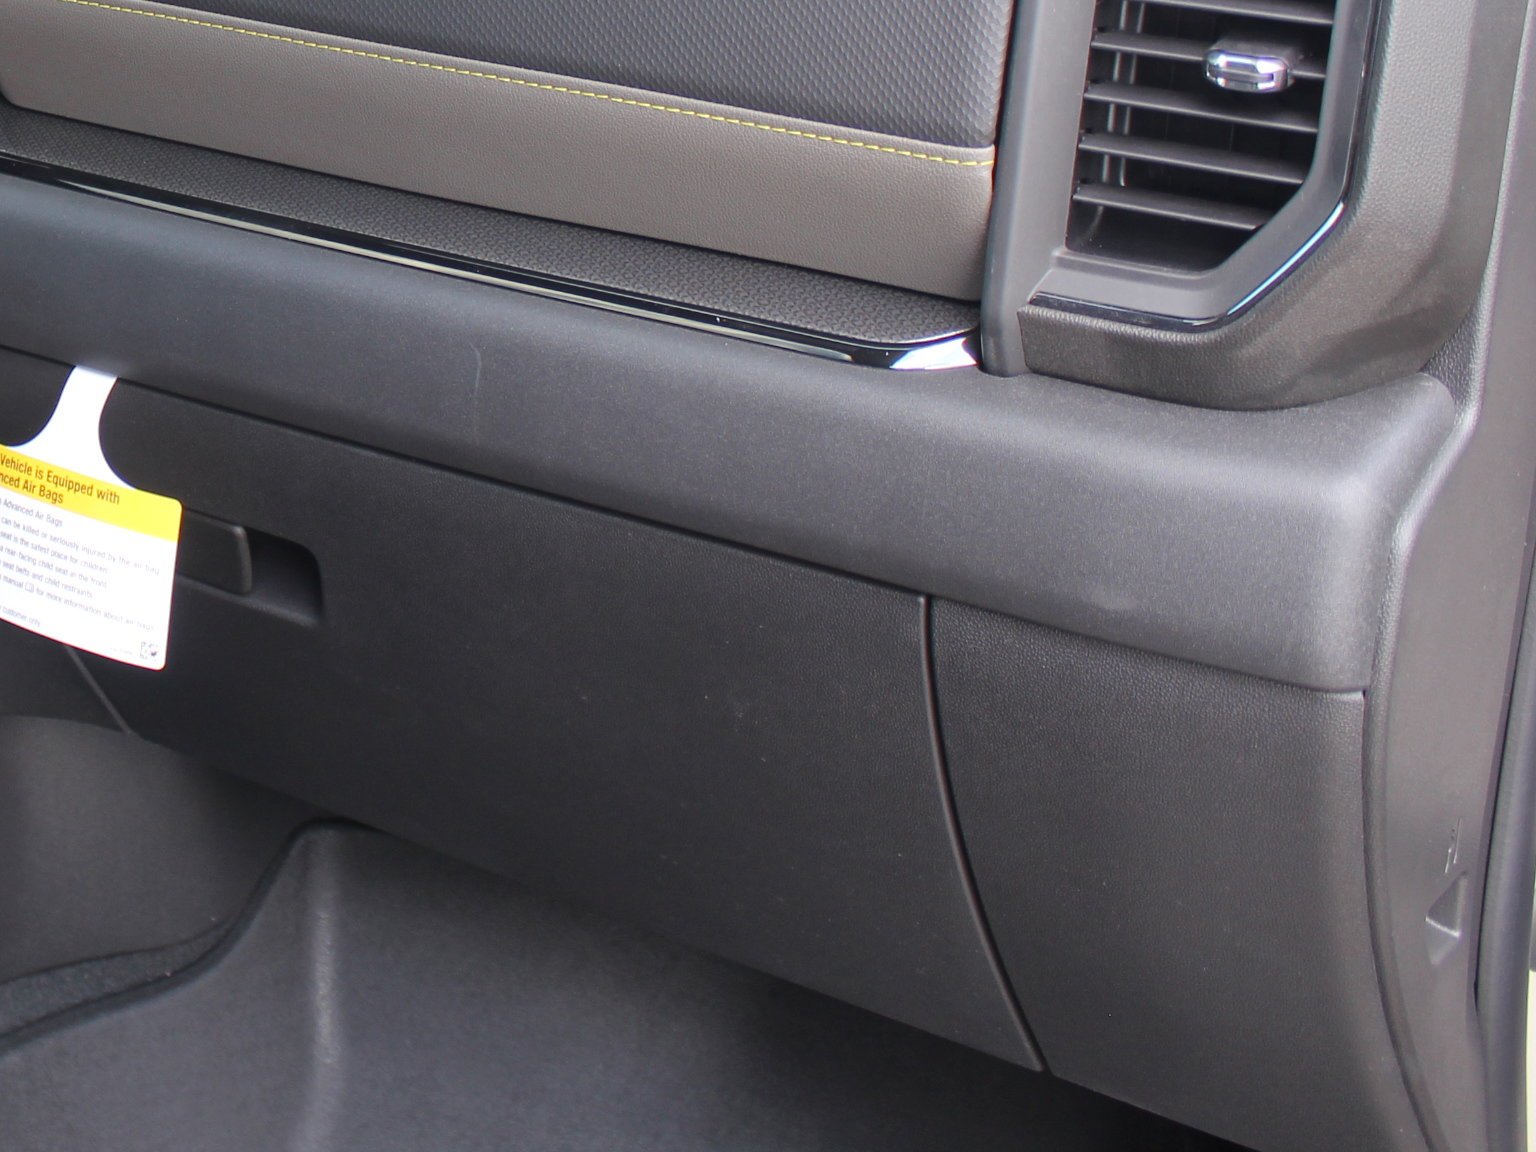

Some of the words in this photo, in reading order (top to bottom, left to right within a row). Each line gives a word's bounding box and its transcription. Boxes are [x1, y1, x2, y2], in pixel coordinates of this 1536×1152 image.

[0, 453, 32, 476] Vehicle
[35, 466, 43, 480] is
[47, 470, 94, 497] Equipped
[96, 488, 120, 505] with
[22, 479, 36, 495] Air
[38, 485, 64, 505] Bags
[3, 498, 34, 517] Advanced
[35, 510, 44, 520] Air
[46, 513, 62, 527] Bags
[0, 531, 13, 541] seat
[13, 535, 19, 543] is
[19, 537, 29, 548] the
[31, 542, 49, 554] safest
[51, 550, 68, 561] place
[70, 555, 78, 564] for
[1, 517, 12, 526] can
[13, 519, 21, 529] be
[22, 524, 40, 536] killed
[49, 534, 79, 551] seriously
[82, 544, 106, 558] injured
[107, 552, 116, 563] by
[119, 555, 131, 565] the
[2, 560, 15, 571] seat
[16, 565, 30, 577] belts
[31, 572, 44, 582] and
[45, 577, 61, 588] child
[38, 559, 54, 570] child
[55, 566, 69, 576] seat
[79, 573, 88, 583] the
[2, 606, 28, 621] customer
[3, 575, 24, 588] manual
[36, 587, 44, 596] for
[46, 592, 62, 602] more
[64, 599, 102, 616] information
[104, 612, 124, 624] about
